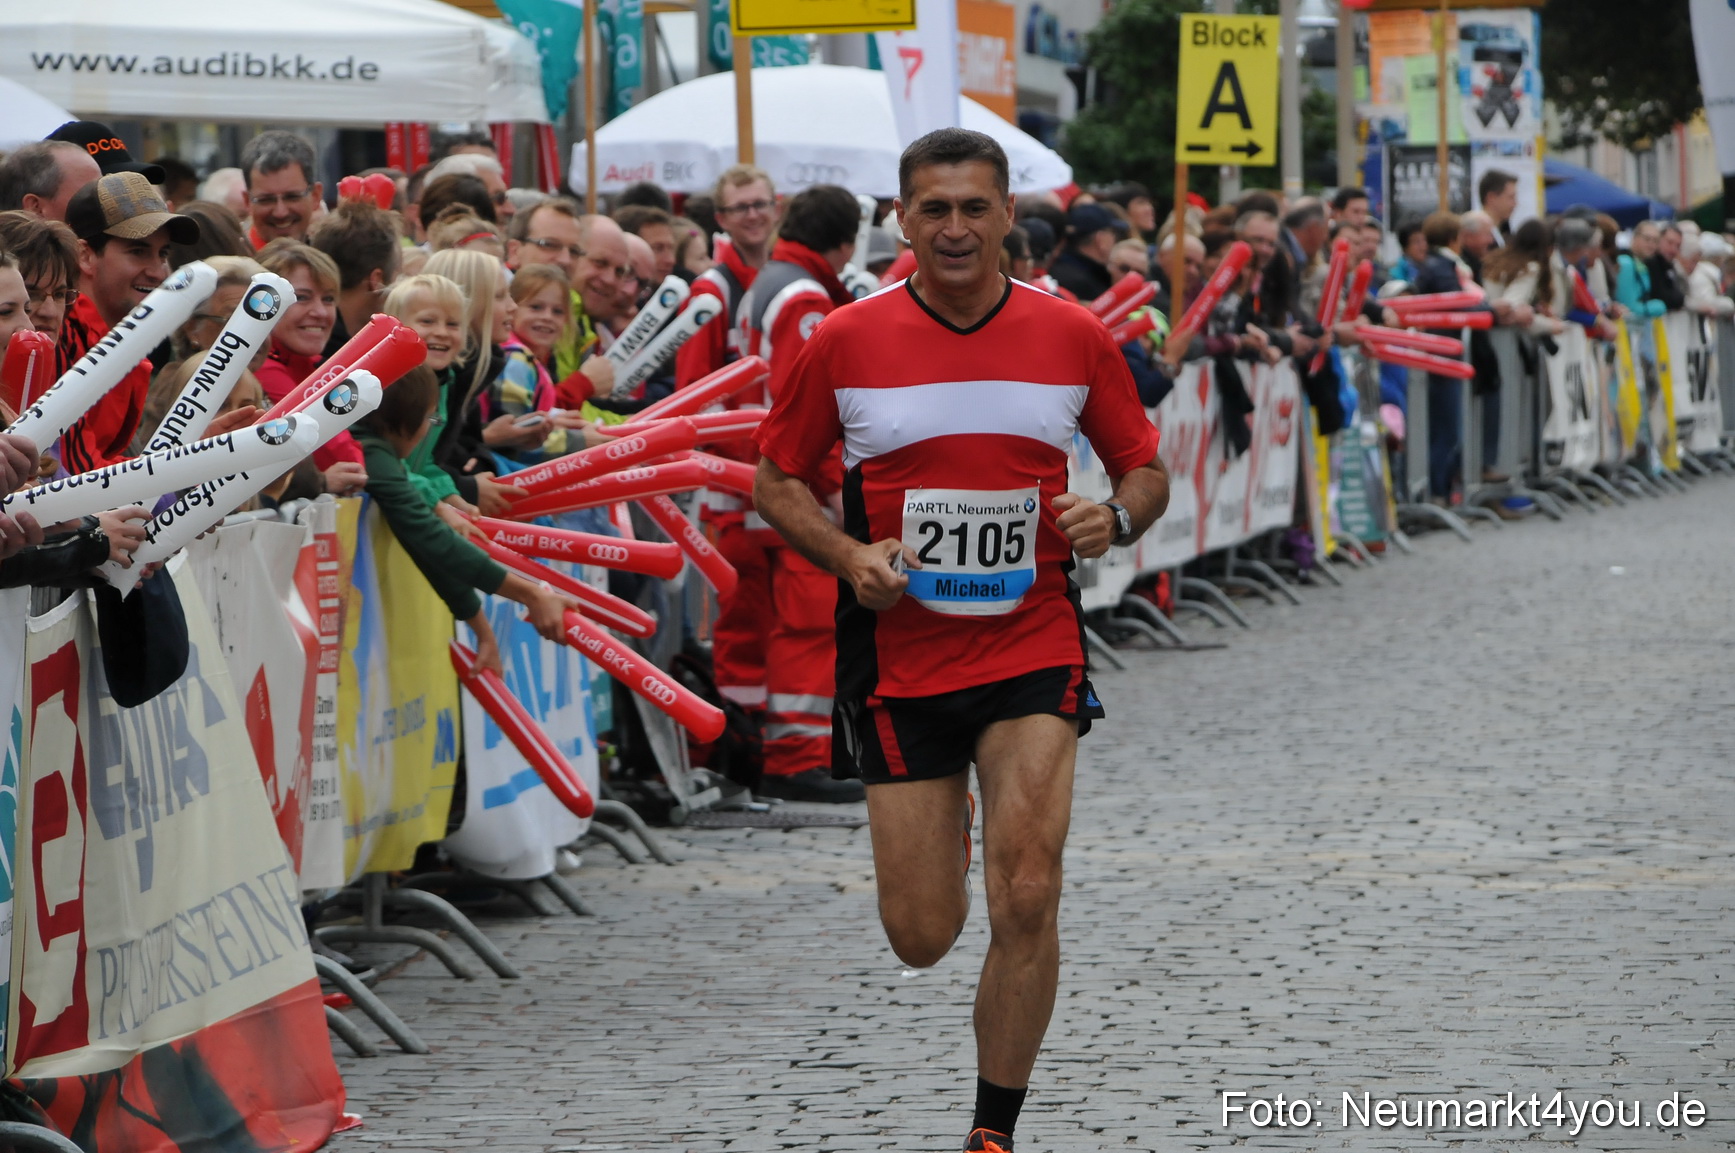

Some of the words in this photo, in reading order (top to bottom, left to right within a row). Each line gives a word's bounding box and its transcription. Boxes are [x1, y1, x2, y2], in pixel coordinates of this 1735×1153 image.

[1192, 20, 1267, 46] Block
[31, 51, 381, 82] www.audibkk.de
[1199, 60, 1254, 130] A
[603, 163, 655, 182] Audi
[620, 312, 659, 356] BMW
[512, 466, 554, 488] Audi
[557, 454, 593, 475] BKK
[906, 502, 953, 514] PARTL
[957, 503, 1019, 515] Neumarkt
[493, 529, 534, 547] Audi
[538, 535, 575, 553] BKK
[917, 520, 1026, 567] 2105
[935, 578, 1006, 598] Michael
[567, 625, 601, 653] Audi
[602, 647, 636, 675] BKK
